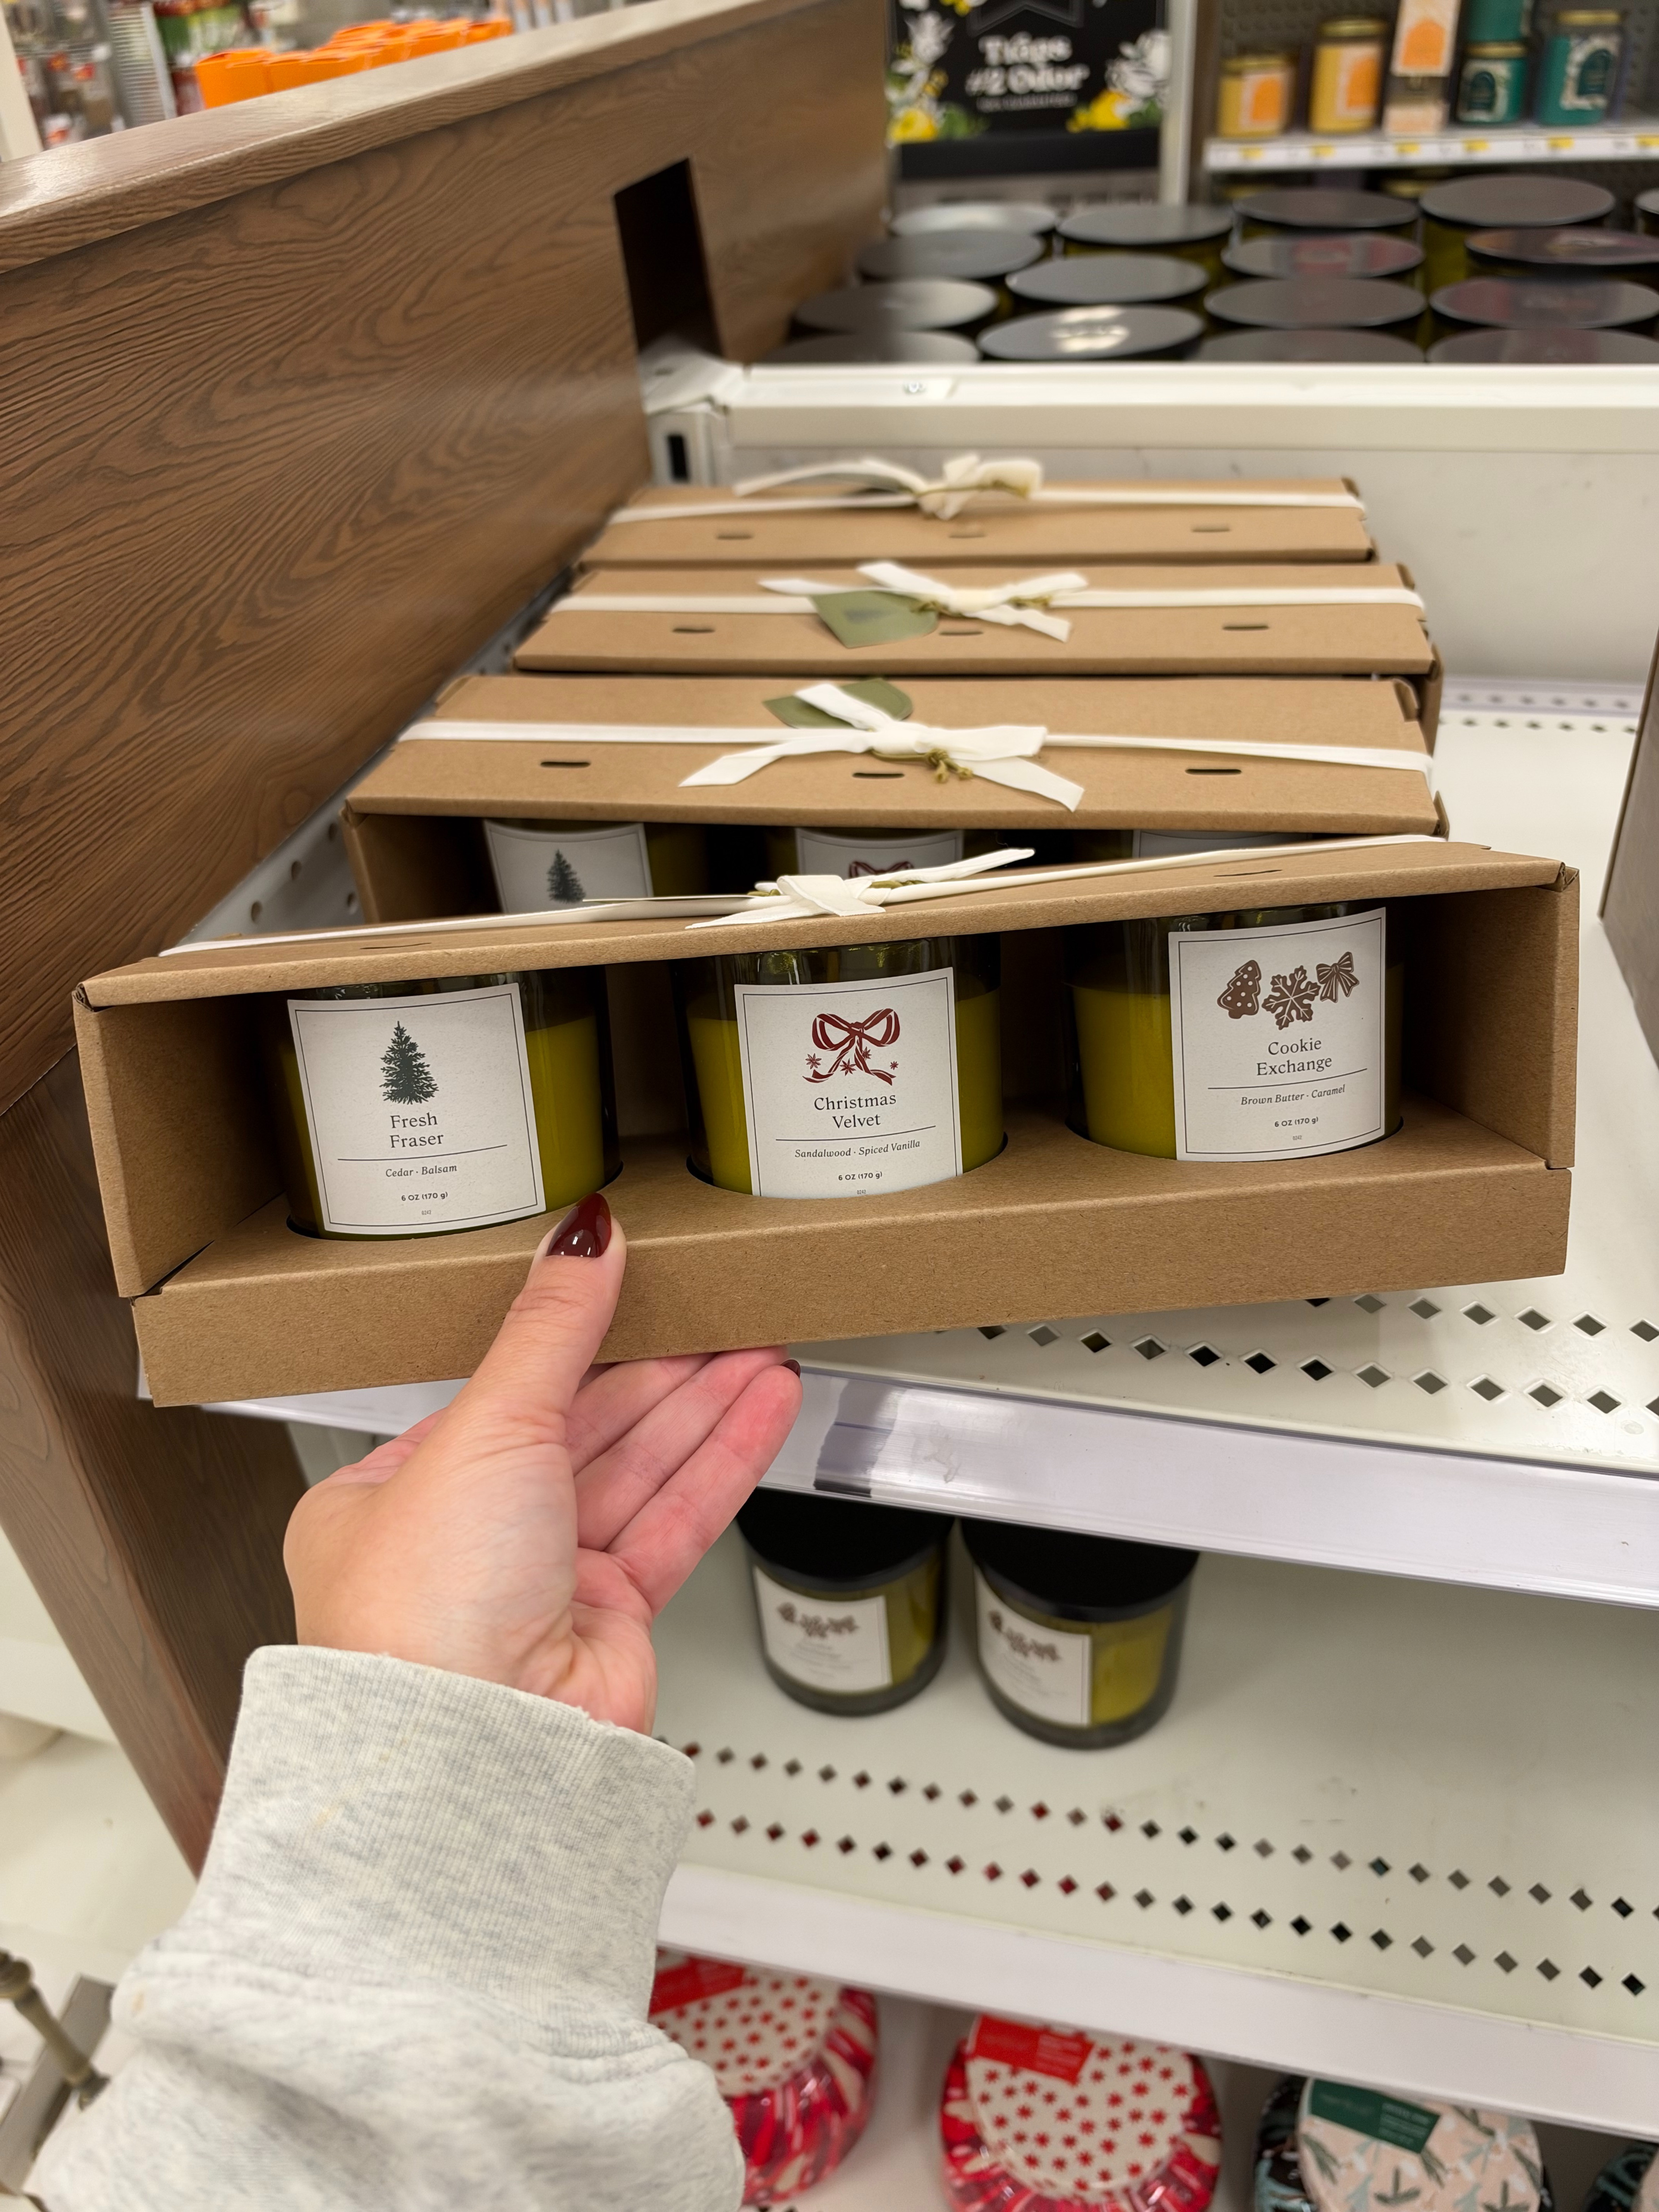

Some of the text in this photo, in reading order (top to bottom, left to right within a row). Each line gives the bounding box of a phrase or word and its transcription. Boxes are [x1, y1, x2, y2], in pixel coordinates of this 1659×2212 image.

[1268, 1037, 1321, 1055] Cookie
[1257, 1057, 1332, 1076] Exchange
[1241, 1084, 1345, 1105] Brown Butter Caramel
[814, 1095, 896, 1110] Christmas
[390, 1112, 438, 1128] Fresh
[832, 1114, 881, 1128] Velvet
[390, 1135, 444, 1148] Fraser
[795, 1140, 920, 1158] Sandalwood Spiced Vanilla
[386, 1165, 457, 1177] Cedar Balsam
[440, 1192, 448, 1200] g)
